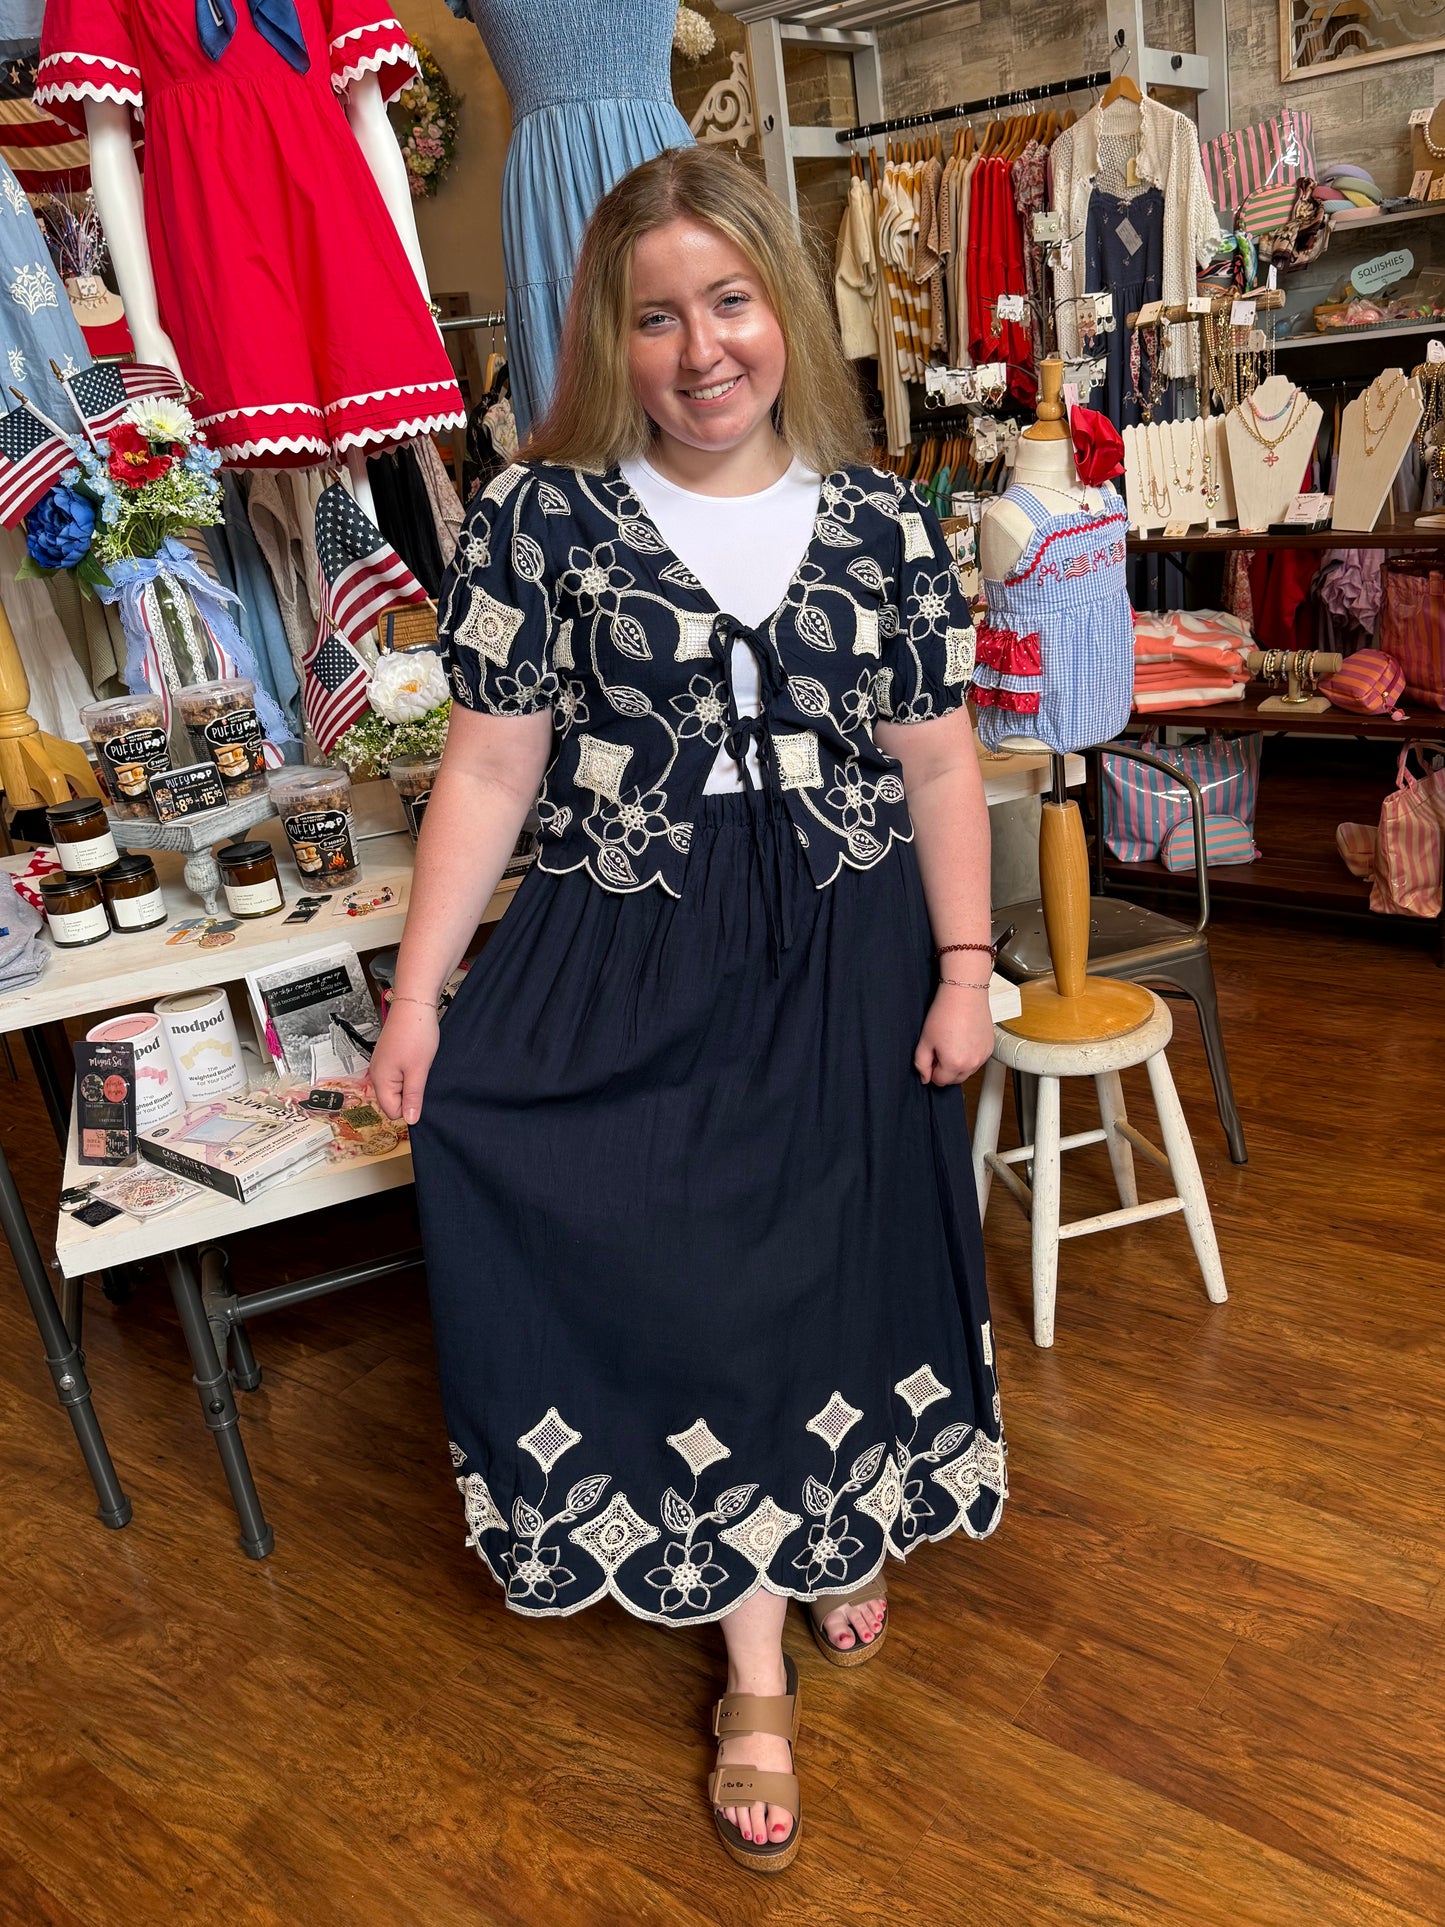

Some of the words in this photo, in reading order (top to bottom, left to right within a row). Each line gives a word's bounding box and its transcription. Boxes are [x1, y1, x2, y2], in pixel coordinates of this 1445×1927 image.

[1358, 254, 1404, 280] SQUISHIES
[211, 723, 243, 738] PUFFY
[110, 742, 144, 757] PUFFY
[165, 775, 190, 789] PUFFY
[190, 769, 212, 781] POP
[175, 797, 194, 812] $8.95
[200, 789, 223, 806] $15.95
[289, 823, 315, 835] PUFFY
[316, 817, 343, 831] POP
[171, 1008, 225, 1034] nodpod
[135, 1035, 161, 1060] pod
[188, 1070, 216, 1082] Weighted
[217, 1063, 237, 1076] Blanket
[206, 1075, 220, 1084] Your
[136, 1100, 154, 1111] ghted
[154, 1091, 173, 1105] Blanket
[143, 1105, 157, 1114] Your
[108, 1139, 124, 1150] Hope
